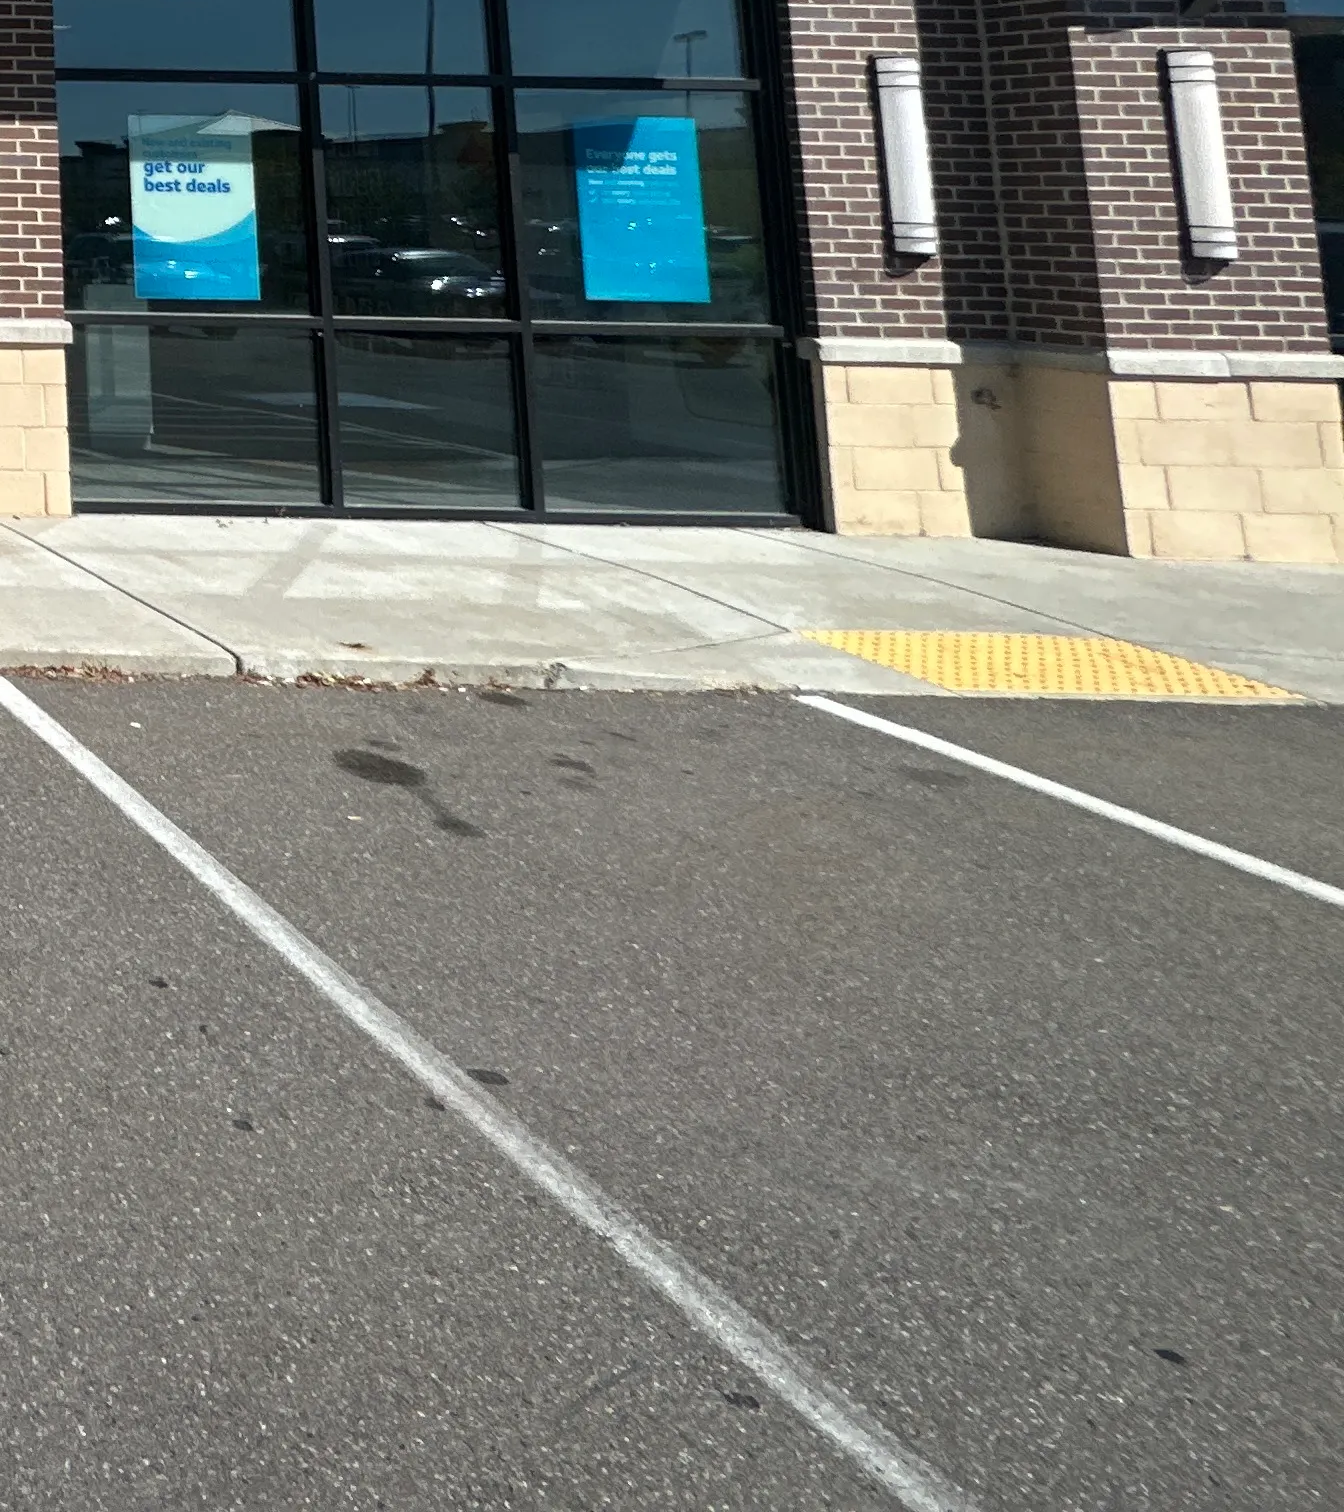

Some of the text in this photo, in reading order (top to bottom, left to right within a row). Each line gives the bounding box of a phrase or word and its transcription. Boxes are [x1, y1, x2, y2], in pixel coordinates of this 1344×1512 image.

[143, 160, 205, 177] get our
[143, 177, 231, 193] best deals
